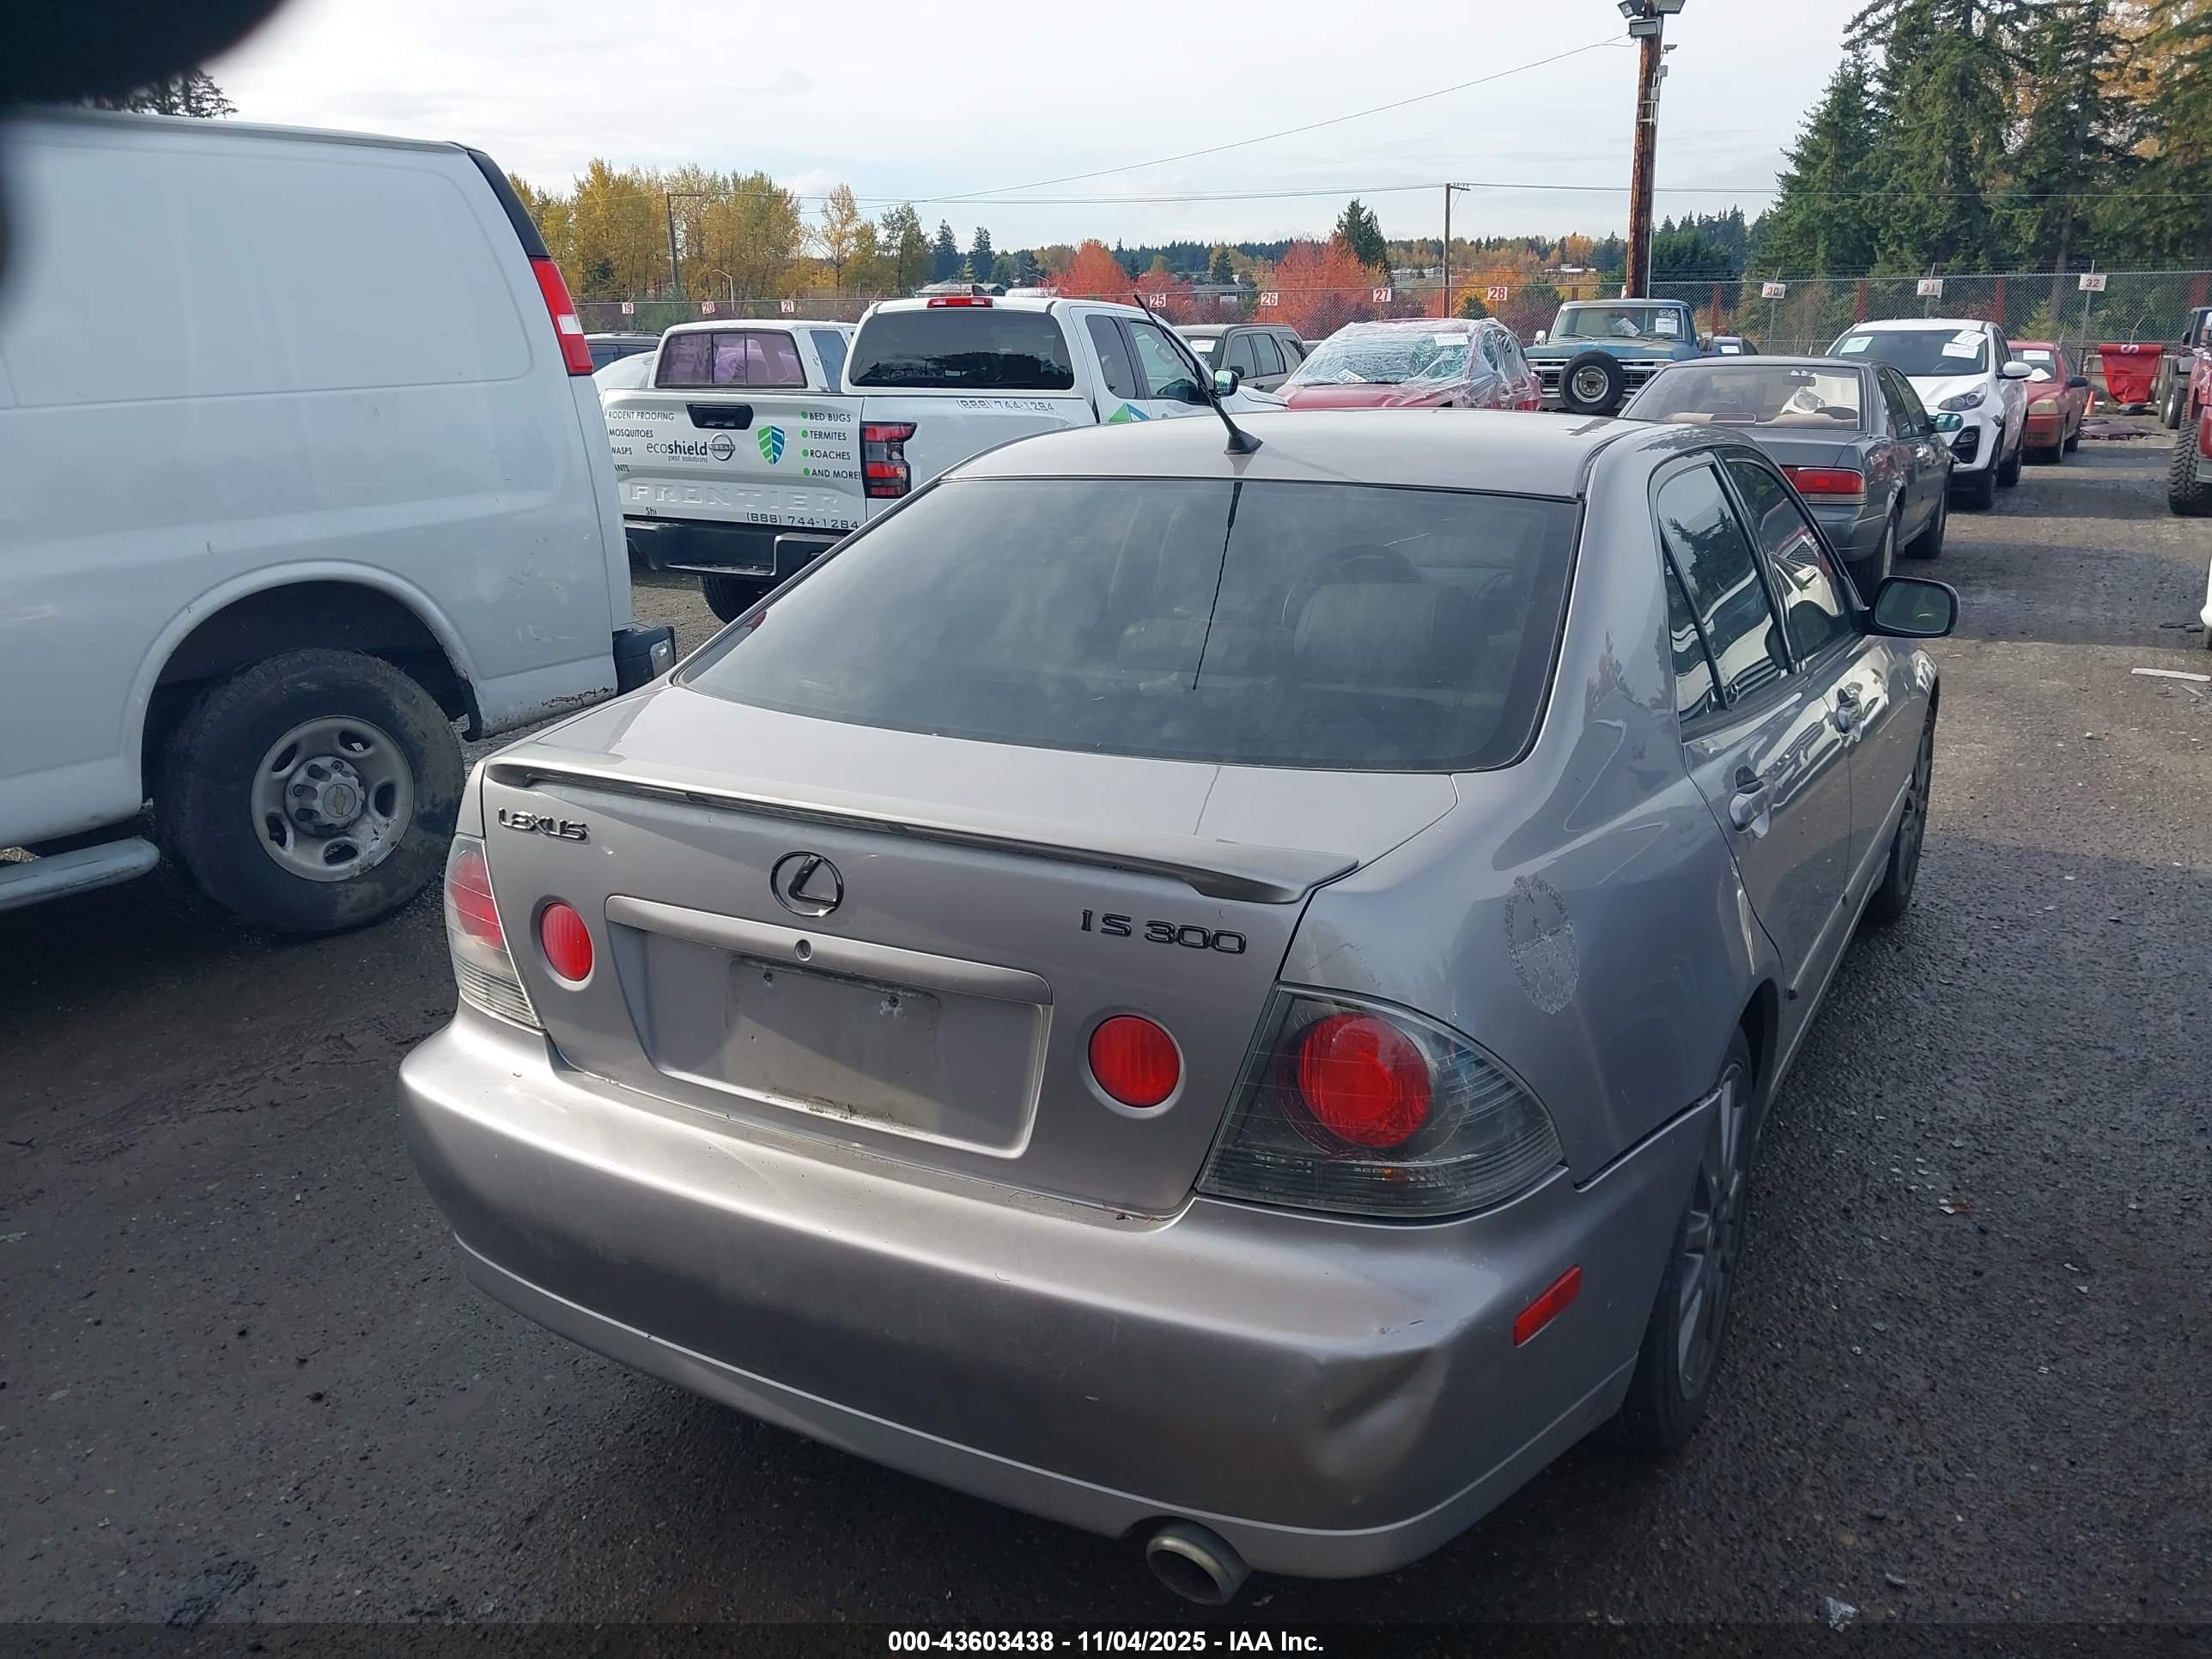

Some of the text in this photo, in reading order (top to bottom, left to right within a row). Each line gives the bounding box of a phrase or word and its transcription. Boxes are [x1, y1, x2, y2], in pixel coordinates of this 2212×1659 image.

[2086, 279, 2100, 288] 32
[1376, 289, 1389, 301] 27
[1489, 288, 1505, 300] 28
[1767, 287, 1779, 295] 30
[1152, 295, 1164, 307] 25
[1262, 293, 1276, 305] 26
[624, 303, 632, 313] 19
[703, 303, 714, 313] 20
[783, 301, 792, 312] 21
[956, 399, 1054, 411] (888) 744-1284
[609, 411, 675, 421] RODENT PROOFING
[810, 412, 851, 422] BED BUGS
[610, 428, 653, 438] MOSQUITOES
[810, 430, 847, 441] TERMITES
[646, 440, 708, 456] ecoshield
[668, 455, 680, 464] pest
[810, 449, 851, 460] ROACHES
[811, 469, 860, 480] AND MORE!
[630, 483, 840, 512] FRONTIER
[746, 512, 859, 529] (888) 744-1284
[497, 807, 588, 841] LEXUS
[1143, 920, 1247, 955] 300
